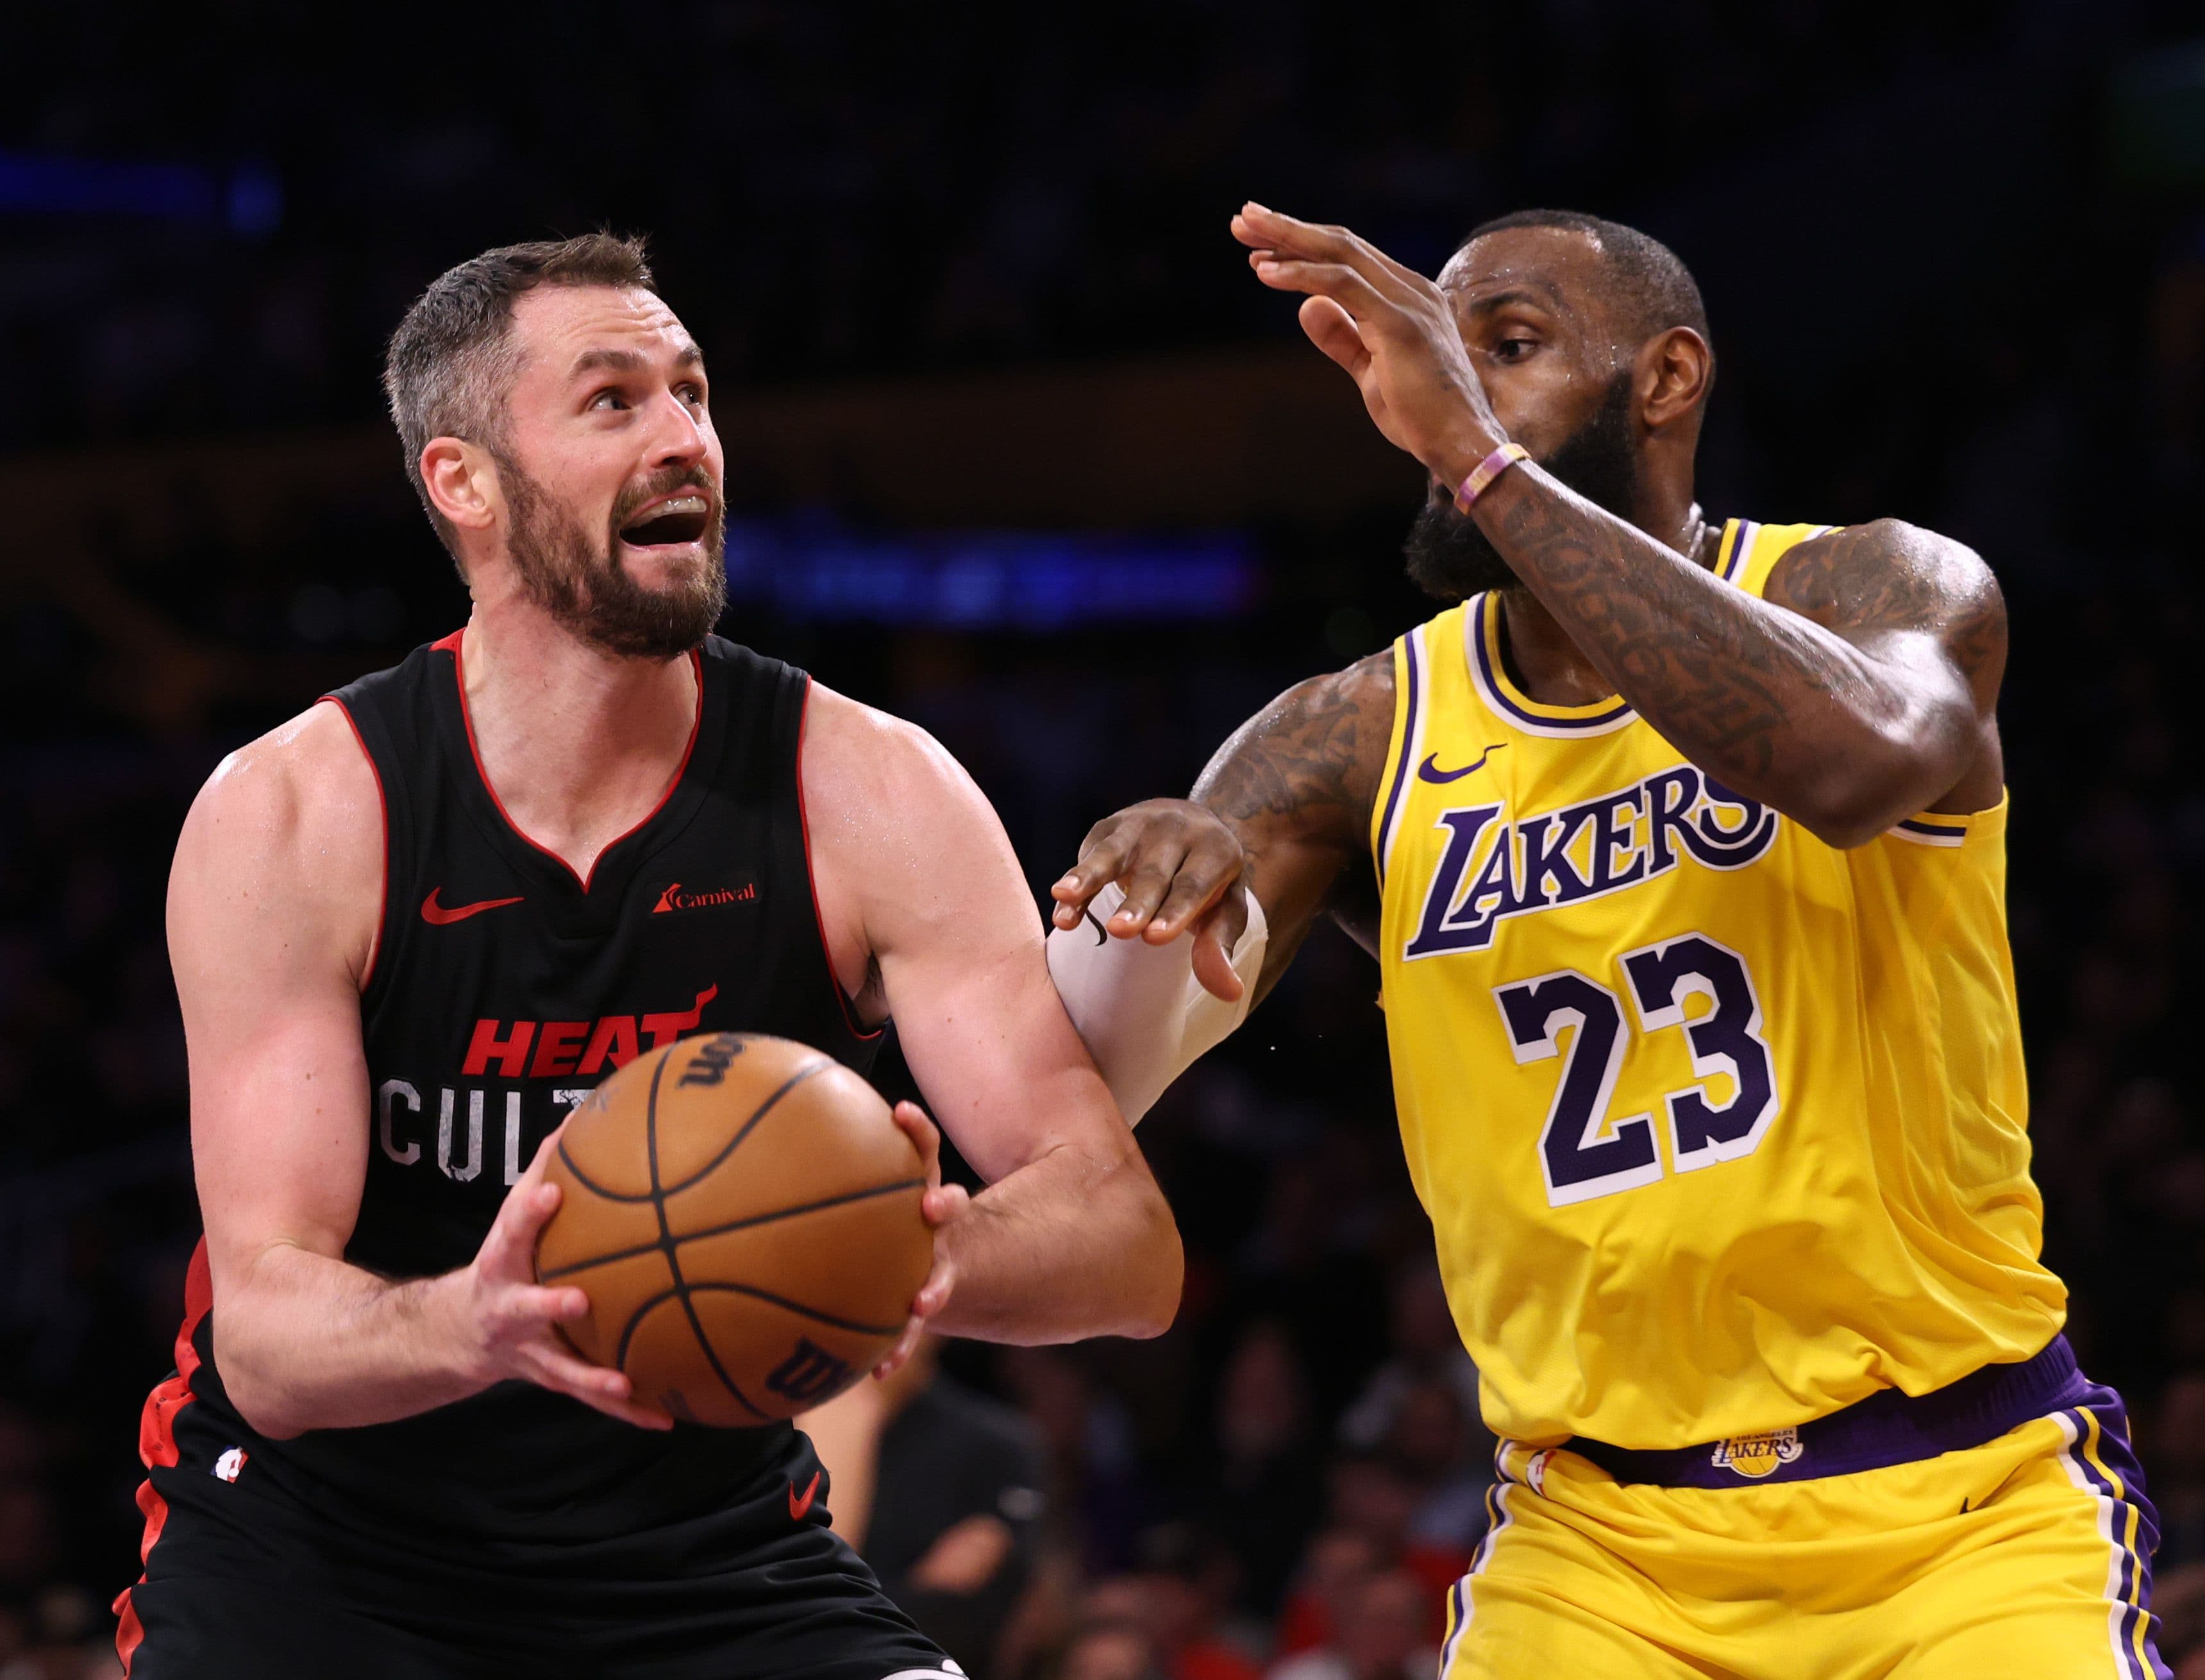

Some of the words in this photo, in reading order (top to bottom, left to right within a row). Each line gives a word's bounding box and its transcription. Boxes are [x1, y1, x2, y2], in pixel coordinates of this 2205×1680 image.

[675, 883, 755, 908] Carnival
[1402, 762, 1779, 961] LAKERS
[461, 982, 717, 1077] HEAT
[1492, 932, 1779, 1207] 23
[1715, 1437, 1799, 1464] LAKERS
